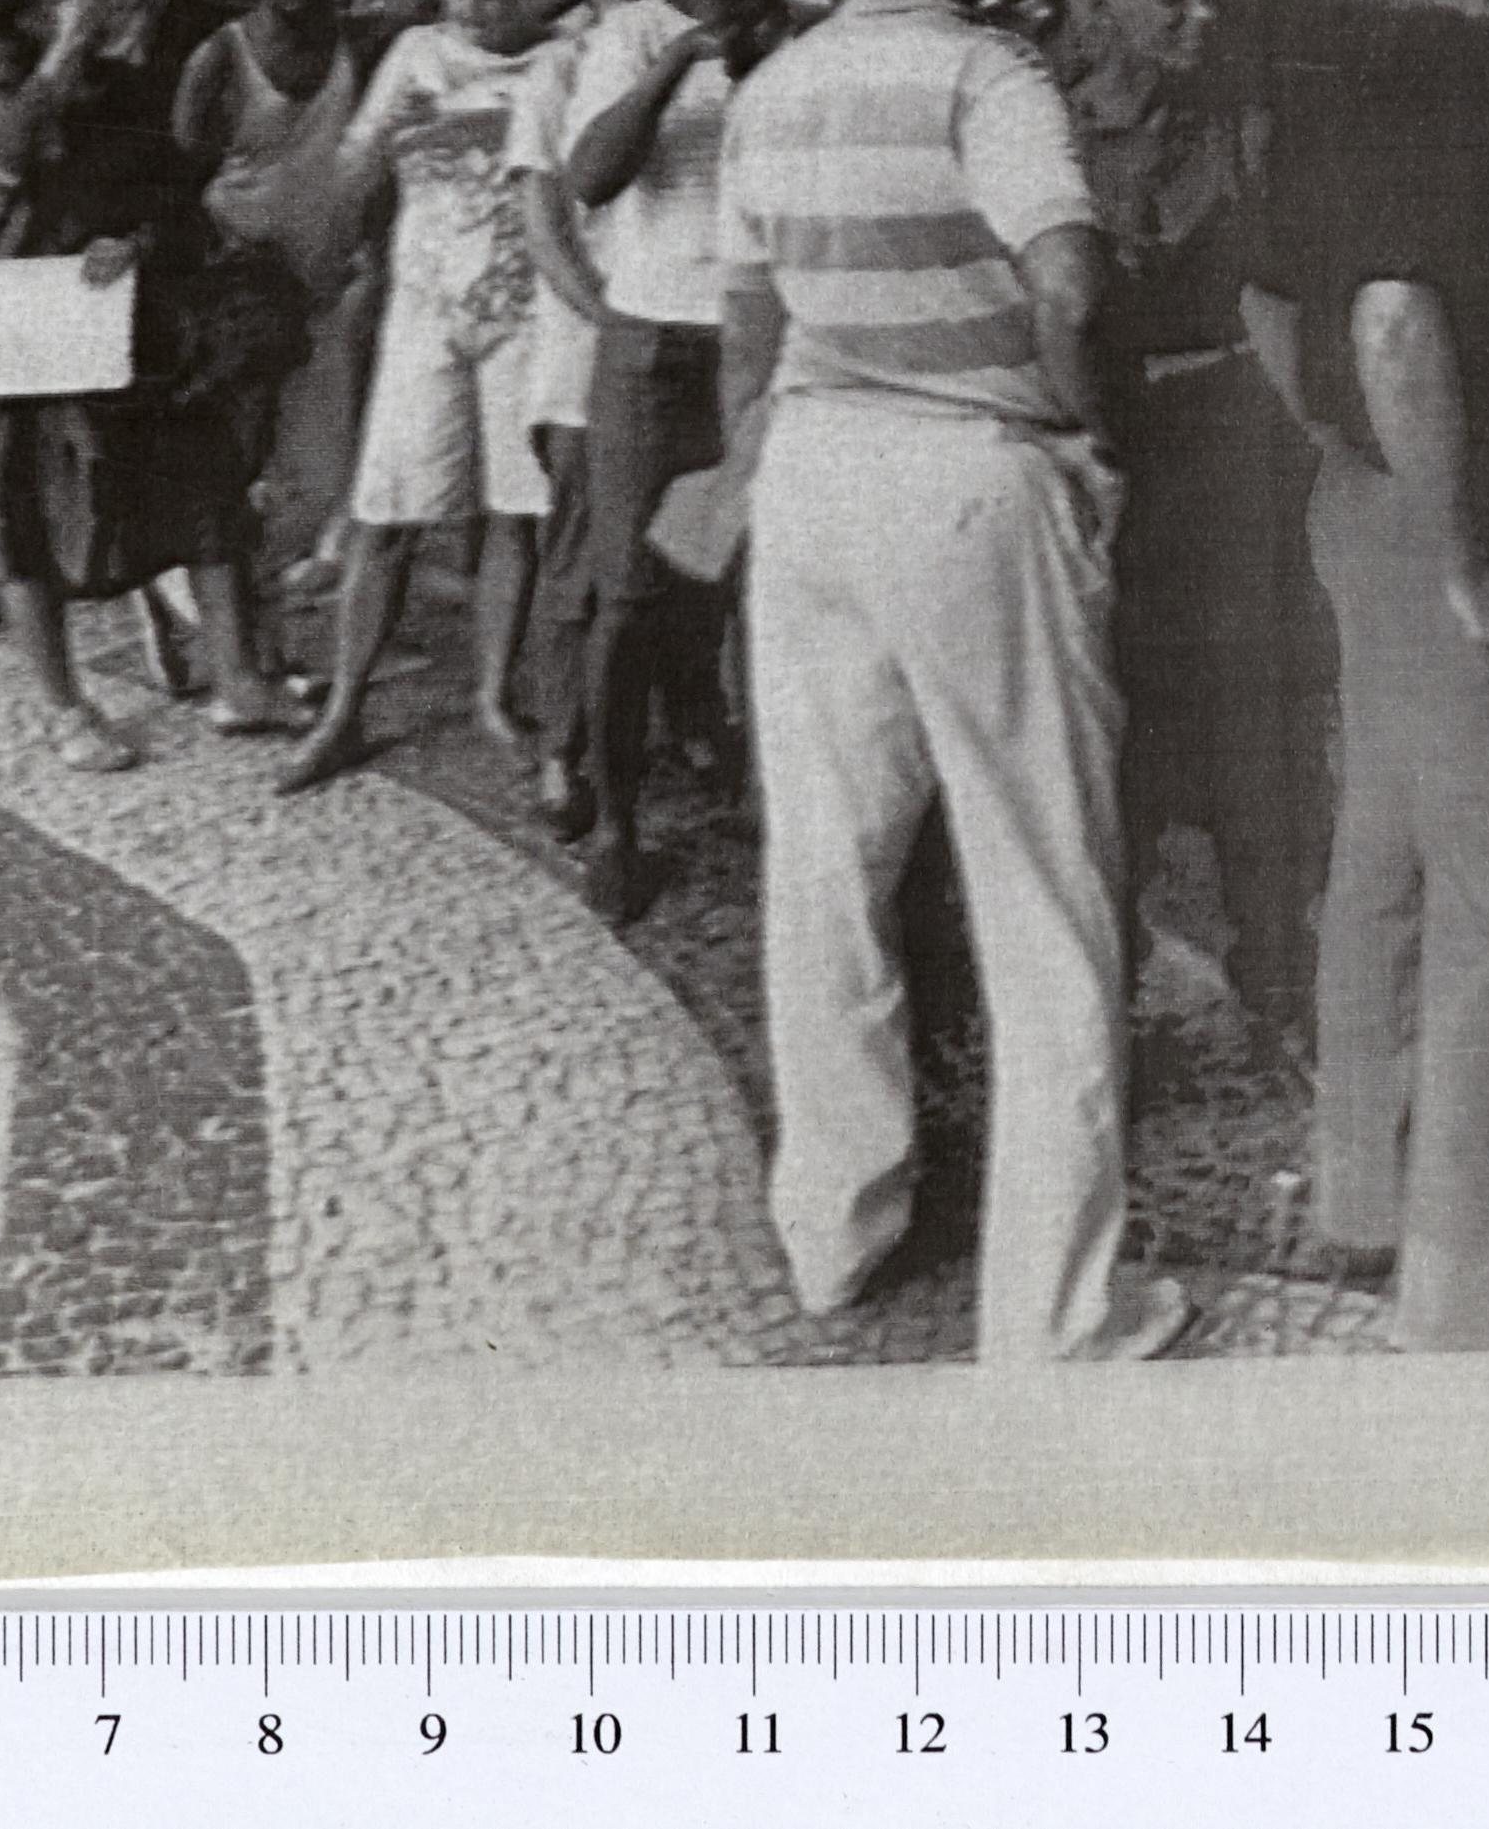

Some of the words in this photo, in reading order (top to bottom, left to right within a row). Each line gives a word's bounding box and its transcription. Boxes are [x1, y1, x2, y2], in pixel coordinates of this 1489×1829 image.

[95, 1713, 122, 1756] 7
[257, 1713, 284, 1755] 8
[419, 1713, 448, 1755] 9
[573, 1712, 623, 1755] 10
[735, 1712, 782, 1754] 11
[897, 1712, 947, 1754] 12
[1061, 1712, 1110, 1754] 13
[1222, 1712, 1273, 1753] 14
[1386, 1712, 1434, 1754] 15
